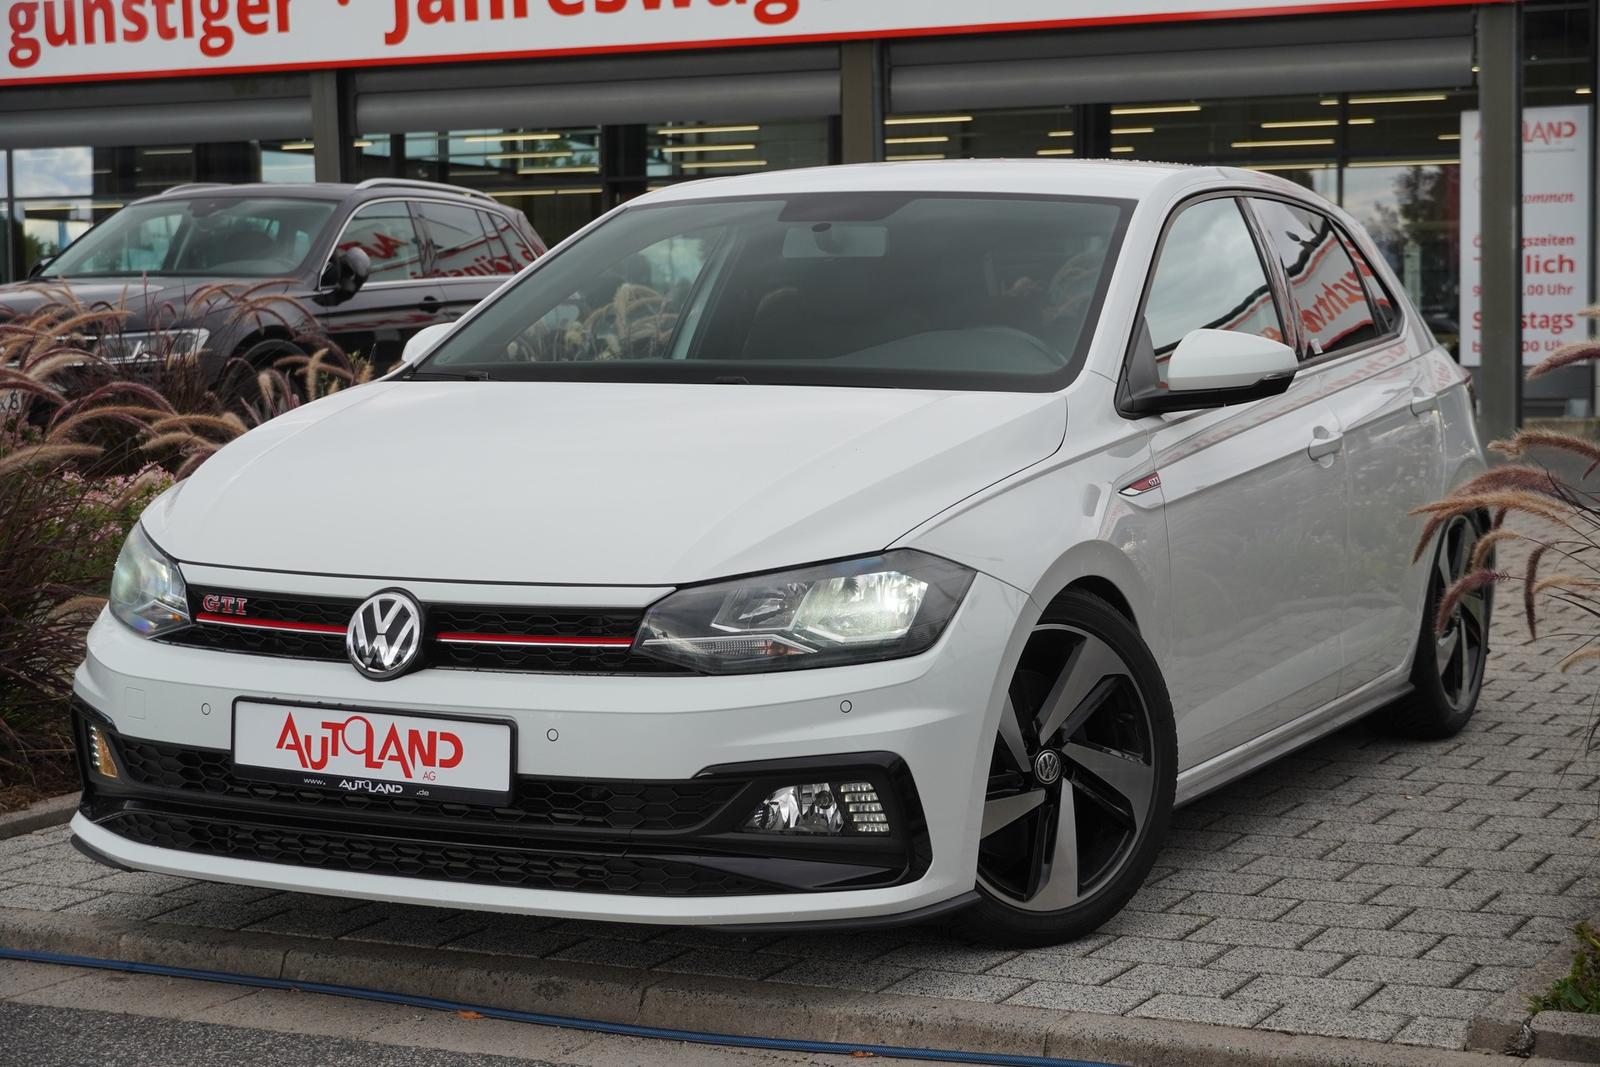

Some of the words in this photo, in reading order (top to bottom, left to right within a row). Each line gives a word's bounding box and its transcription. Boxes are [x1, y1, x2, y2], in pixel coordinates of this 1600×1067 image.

[1547, 284, 1573, 296] Uhr
[202, 594, 248, 616] GTI
[276, 711, 465, 779] AUTOLAND
[422, 770, 437, 782] AG
[303, 777, 327, 786] www.
[339, 778, 404, 795] AUTOLAND
